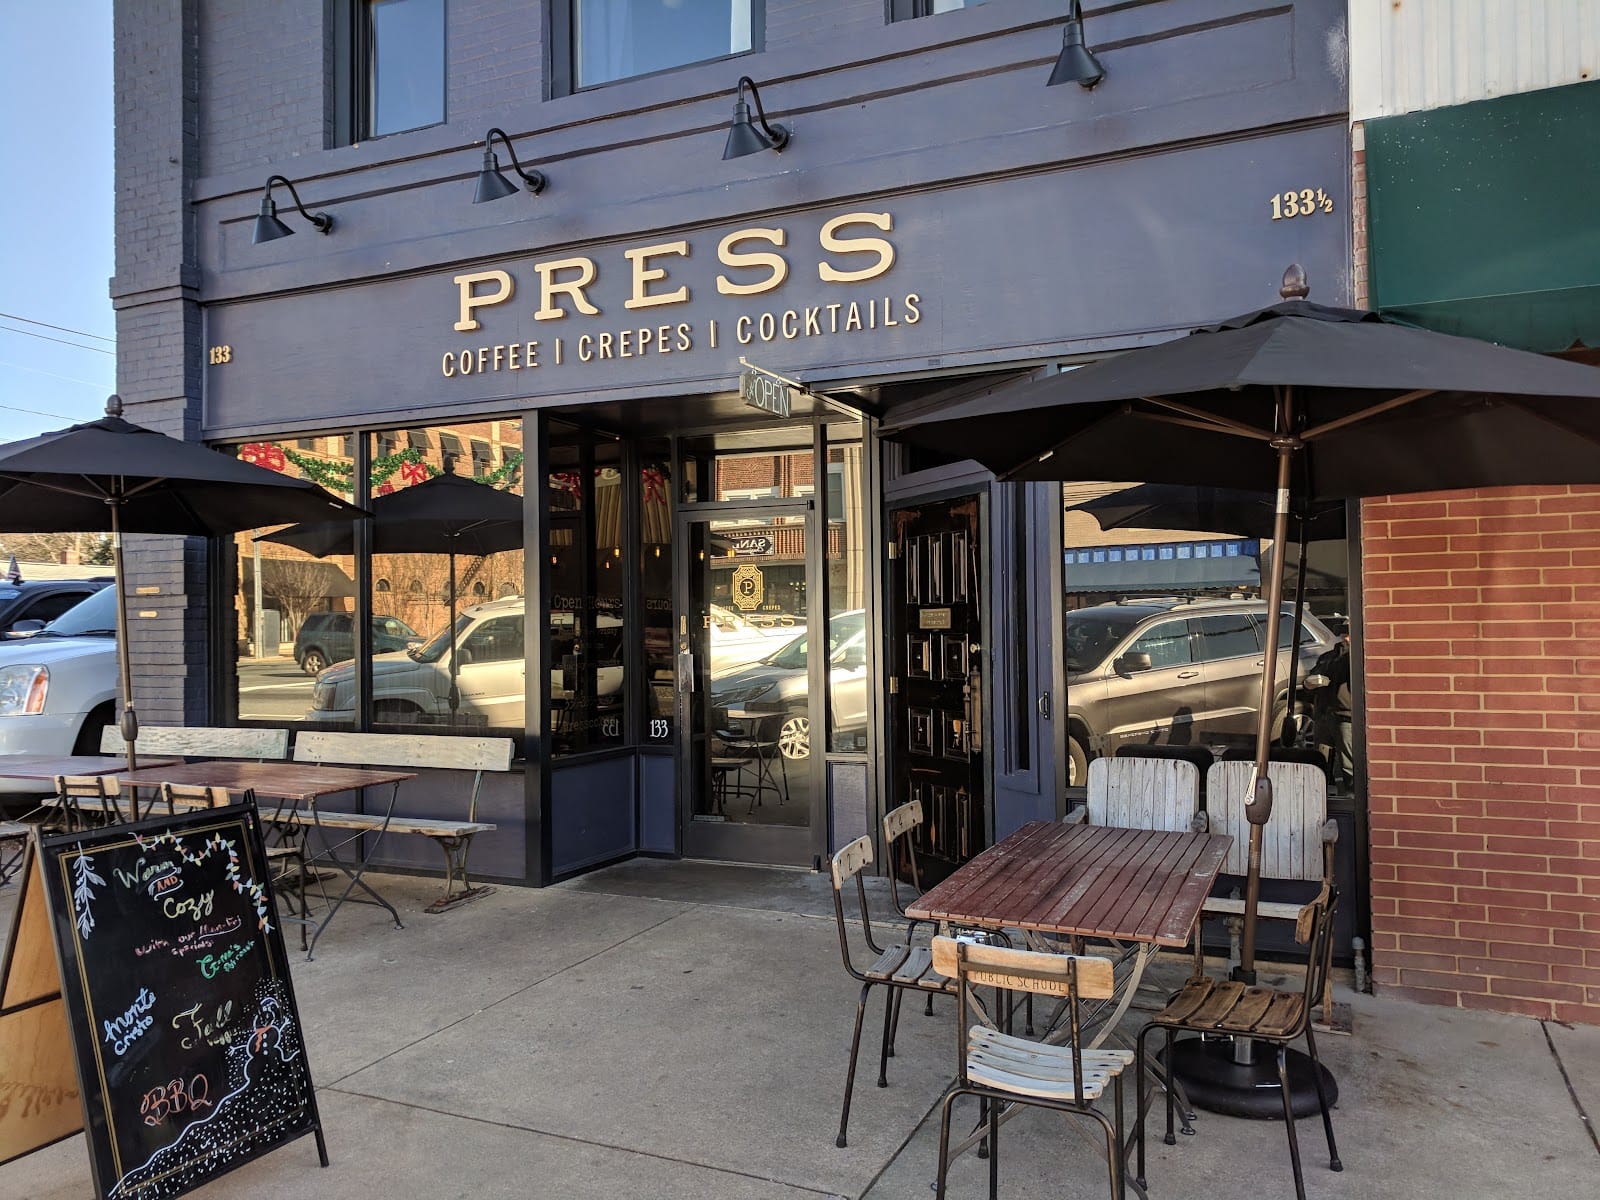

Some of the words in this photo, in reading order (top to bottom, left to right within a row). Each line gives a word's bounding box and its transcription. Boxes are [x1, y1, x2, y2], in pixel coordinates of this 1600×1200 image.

[453, 212, 896, 332] PRESS
[442, 341, 540, 378] COFFEE
[578, 323, 692, 362] CREPES
[736, 293, 922, 344] COCKTAILS
[209, 345, 232, 365] 133
[754, 376, 790, 418] OPEN
[742, 581, 754, 594] P
[554, 594, 583, 613] Open
[702, 614, 795, 629] PRESS
[649, 719, 669, 738] 133
[156, 876, 179, 892] AND
[163, 889, 215, 921] Cozy
[974, 971, 1013, 986] PUBLIC
[140, 1073, 213, 1126] BBQ
